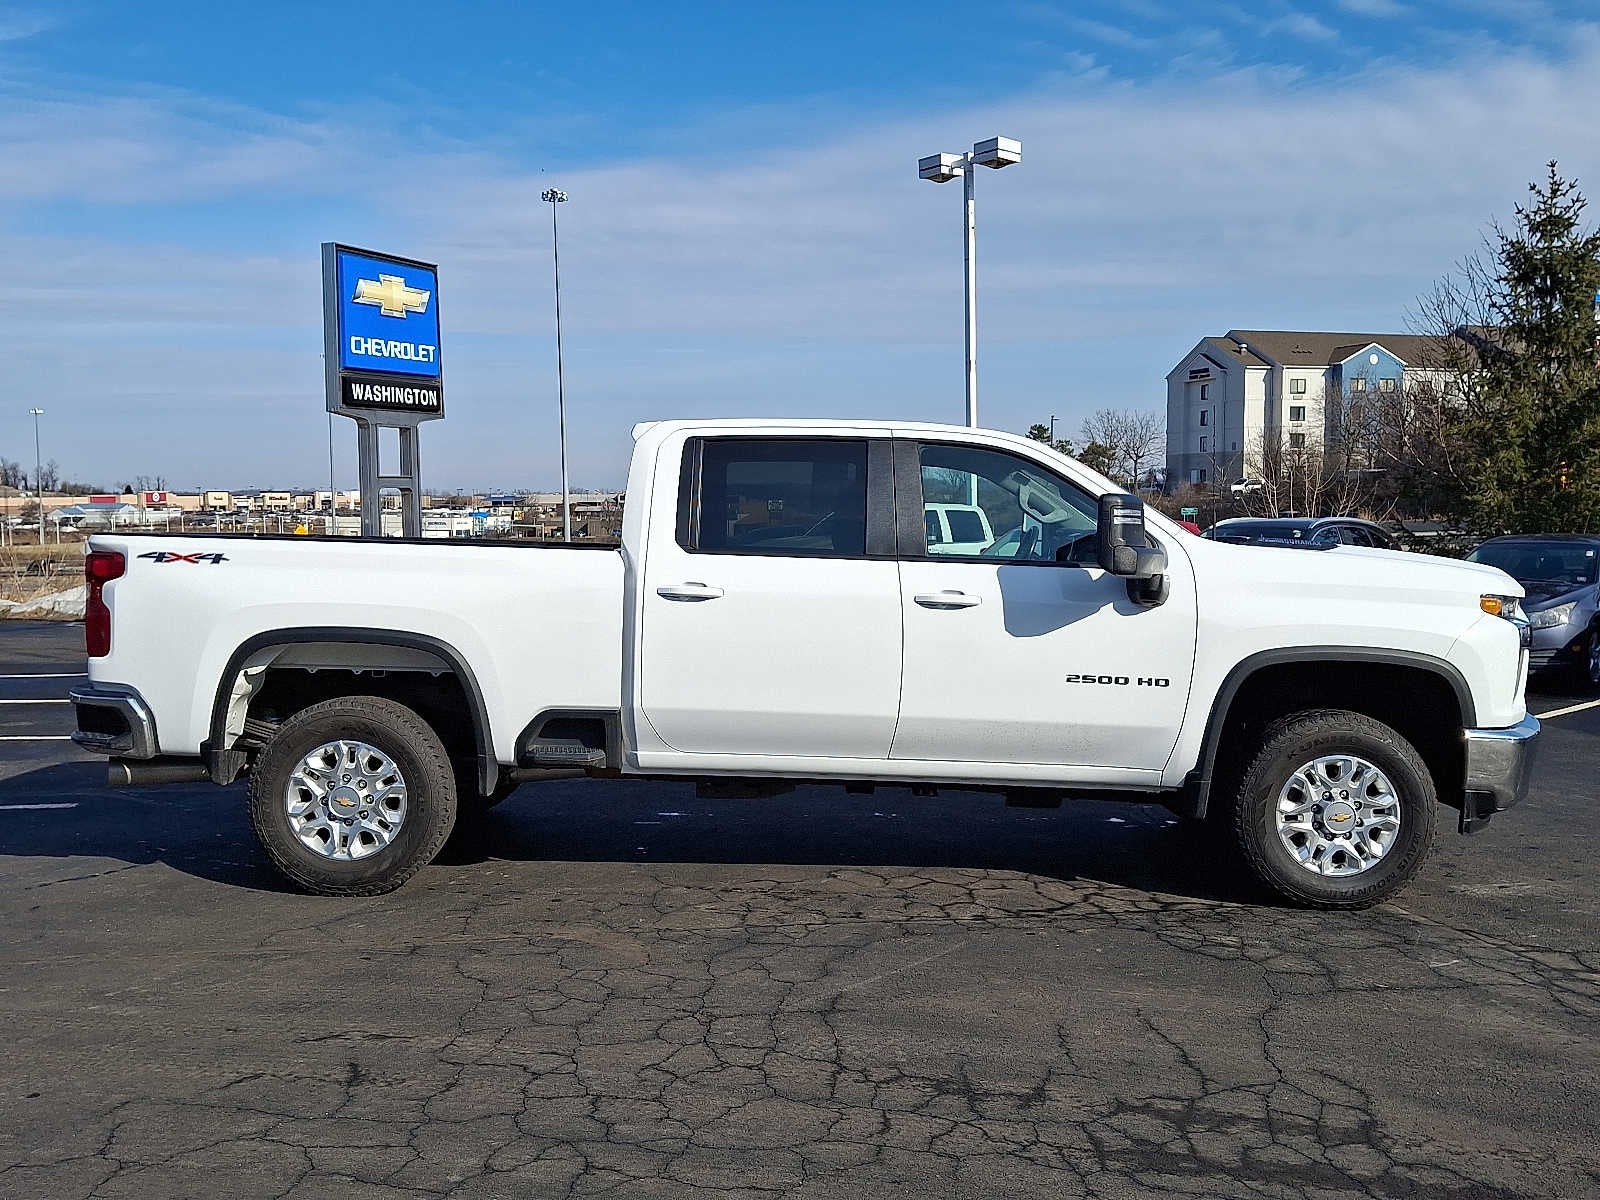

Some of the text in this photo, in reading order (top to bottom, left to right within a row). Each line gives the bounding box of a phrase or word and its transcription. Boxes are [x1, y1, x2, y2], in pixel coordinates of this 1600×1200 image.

[350, 336, 436, 363] CHEVROLET
[351, 382, 438, 406] WASHINGTON
[1065, 674, 1170, 688] 2500 HD
